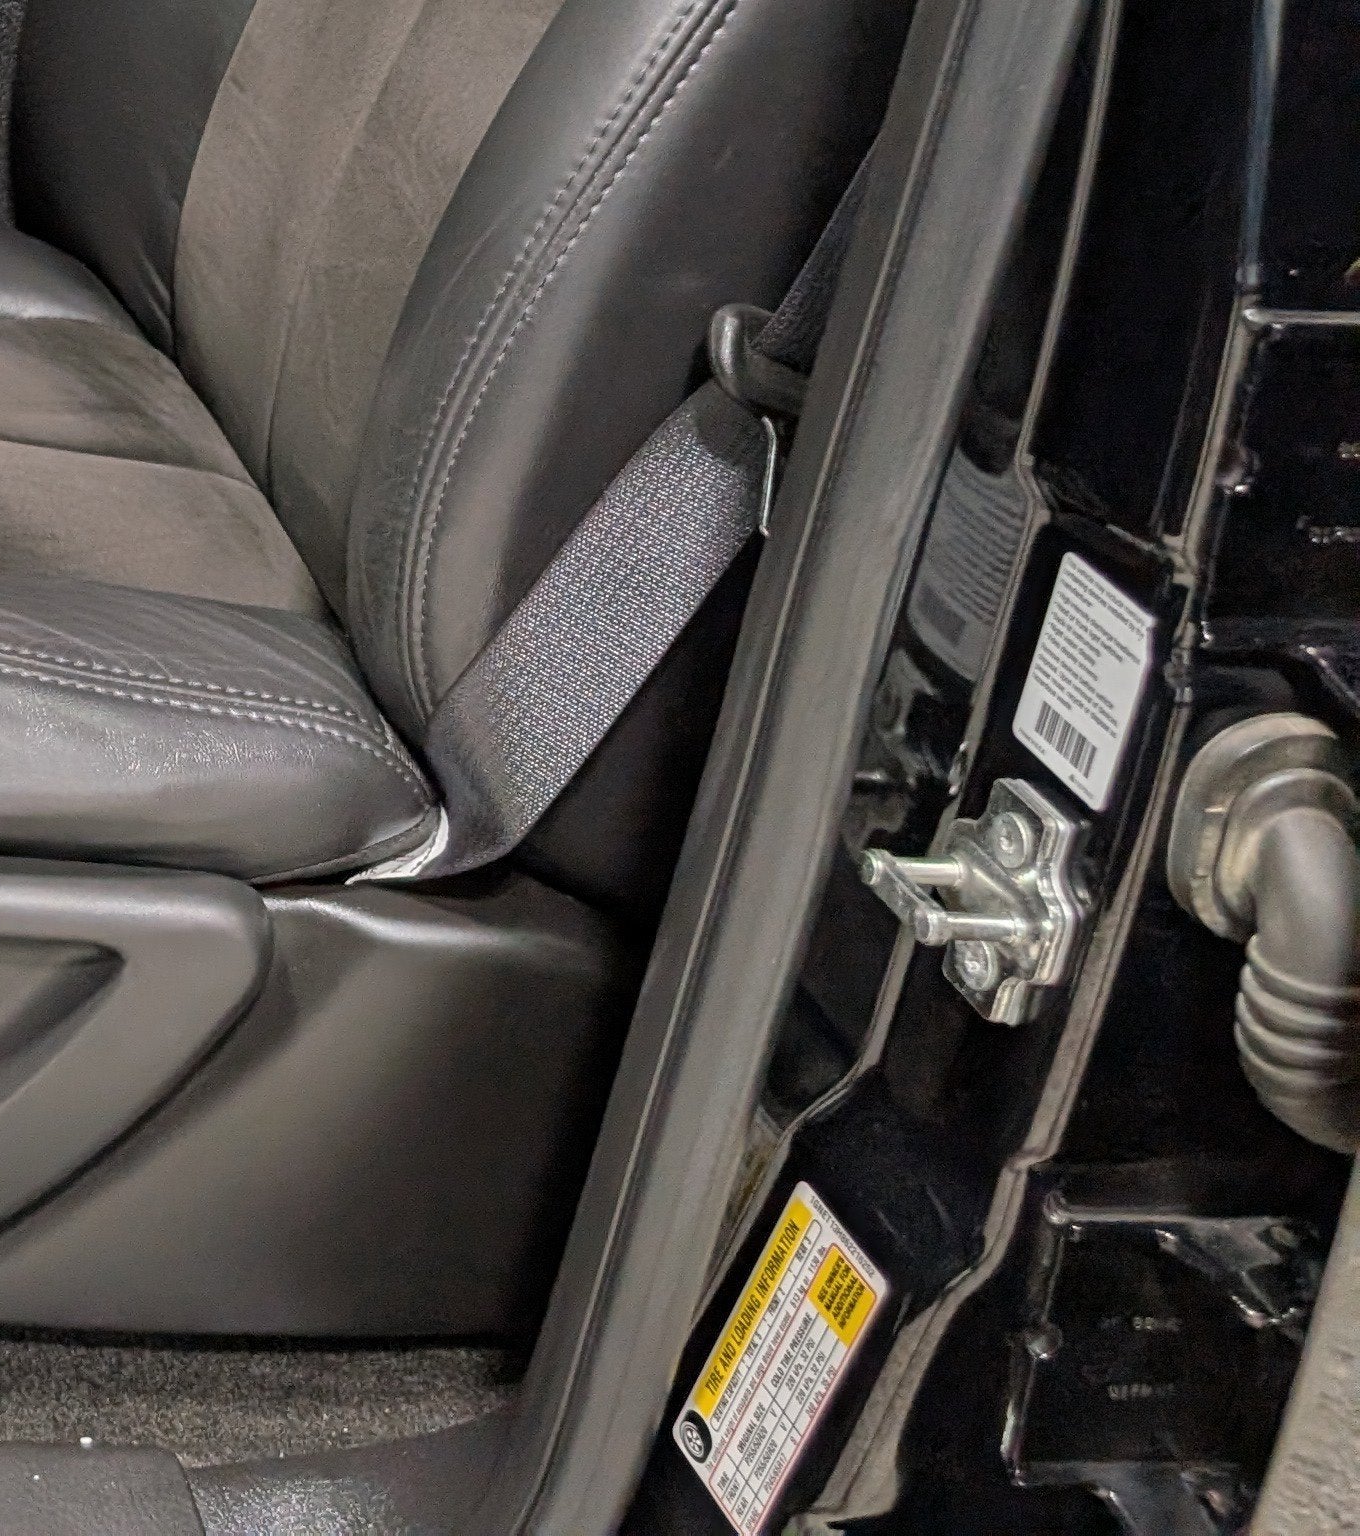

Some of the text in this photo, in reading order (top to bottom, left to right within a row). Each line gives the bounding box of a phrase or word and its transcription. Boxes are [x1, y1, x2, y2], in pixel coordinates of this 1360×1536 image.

[704, 1216, 800, 1398] TIRE AND LOADING INFORMATION
[716, 1310, 813, 1492] TIRE ORIGINAL SIZE COLD TIRE PRESSURE
